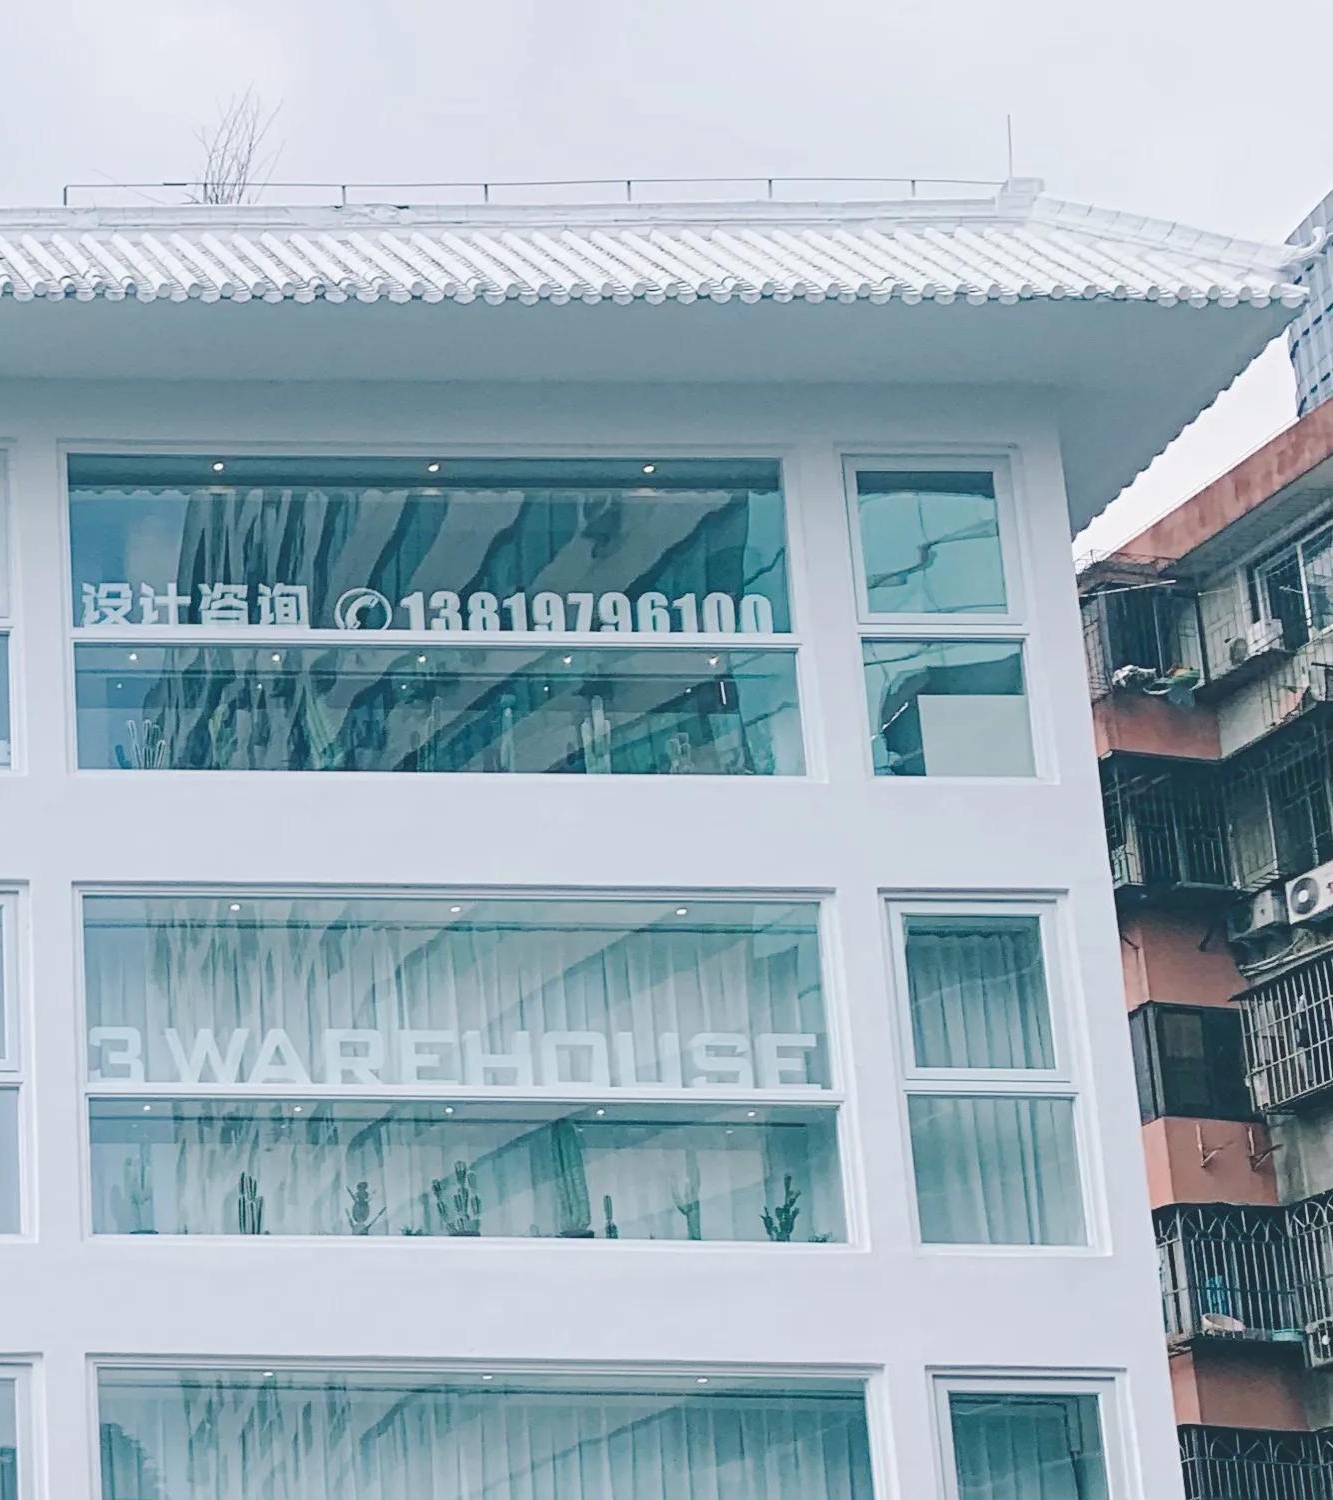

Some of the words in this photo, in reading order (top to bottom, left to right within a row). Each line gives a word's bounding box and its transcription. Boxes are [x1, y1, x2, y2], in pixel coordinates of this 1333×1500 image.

[82, 582, 311, 631] 设计咨询
[400, 590, 774, 635] 13819796100
[87, 1025, 144, 1082] 3
[164, 1026, 821, 1090] WAREHOUSE
